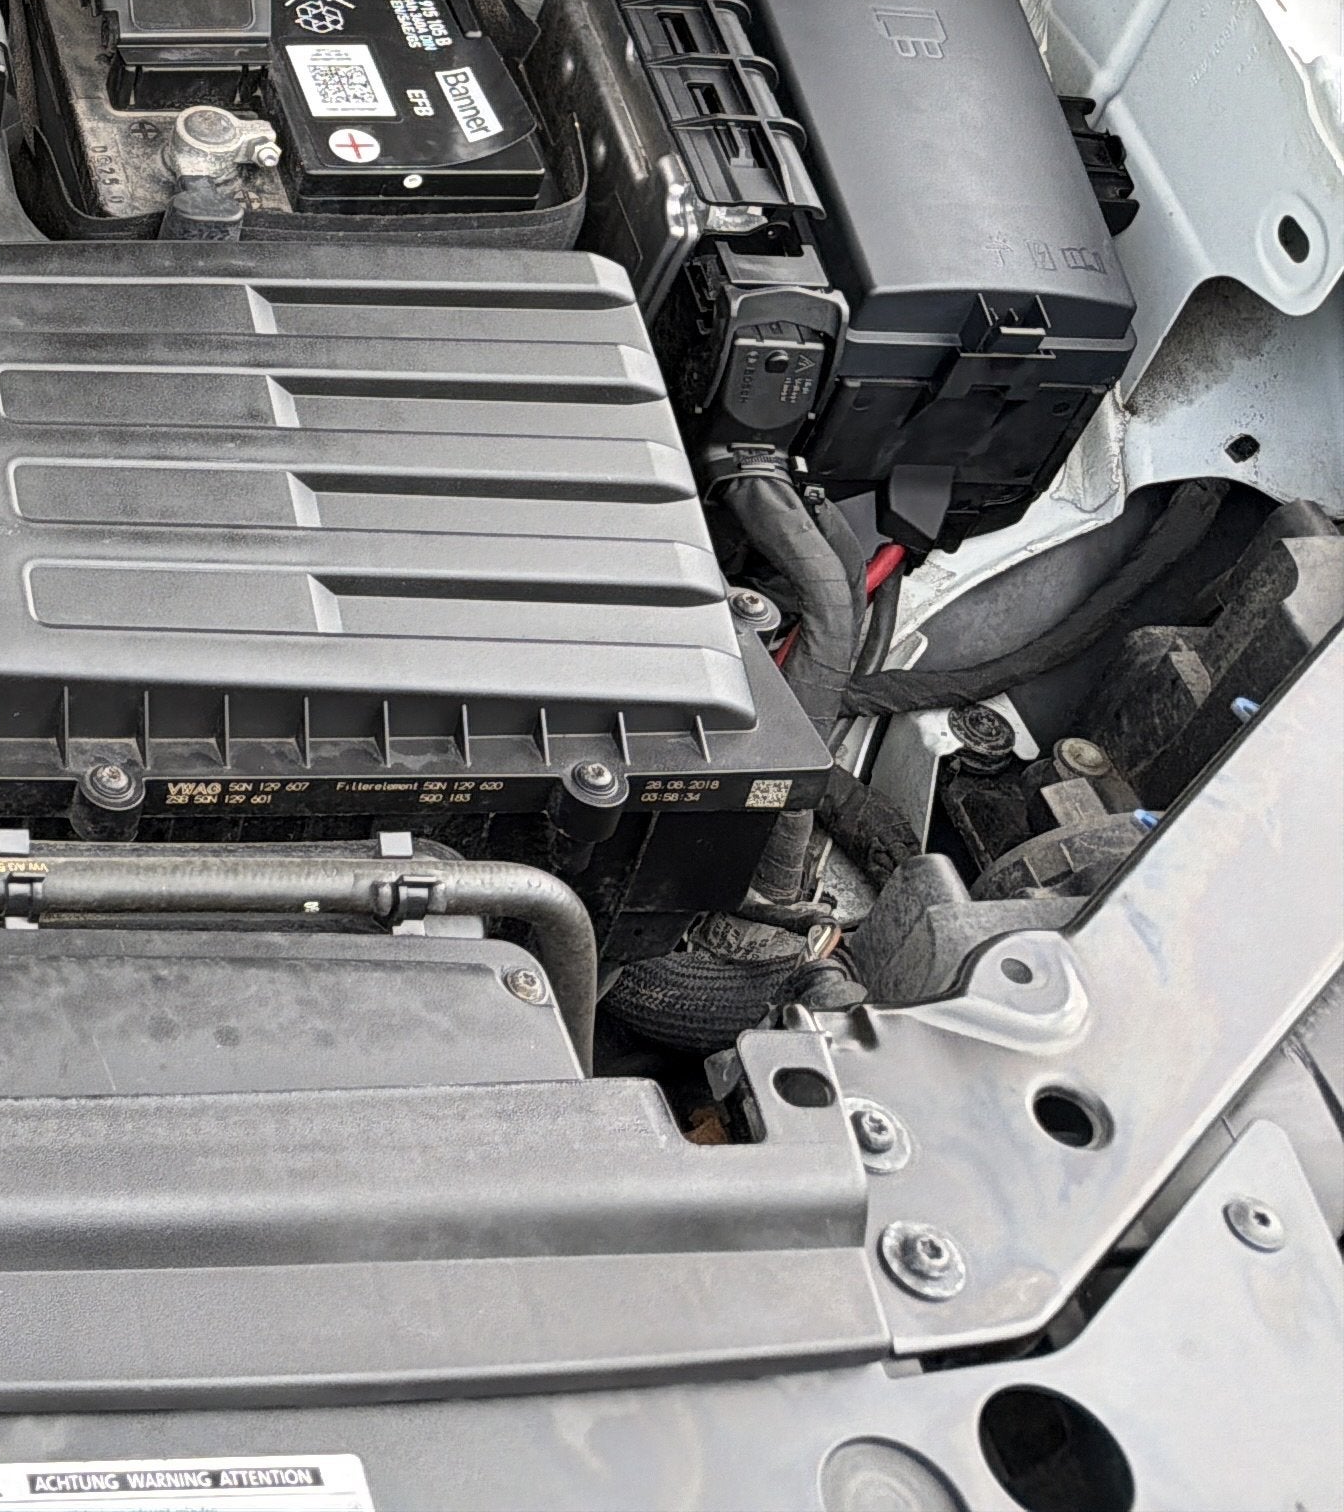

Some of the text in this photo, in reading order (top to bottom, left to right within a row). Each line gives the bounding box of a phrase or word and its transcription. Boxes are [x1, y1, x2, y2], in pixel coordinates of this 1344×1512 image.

[407, 89, 435, 117] EFB
[442, 71, 491, 135] Banner
[259, 781, 281, 792] 129
[285, 781, 310, 792] 607
[336, 781, 418, 792] Filterelement
[453, 781, 475, 791] 129
[479, 781, 504, 791] 620
[644, 780, 720, 790] 28.08.2018
[223, 794, 246, 804] 129
[250, 794, 273, 804] 601
[449, 793, 471, 803] 183
[640, 792, 702, 802] 03:58:34
[33, 1468, 313, 1492] ACHTUNG WARNING ATTENTION
